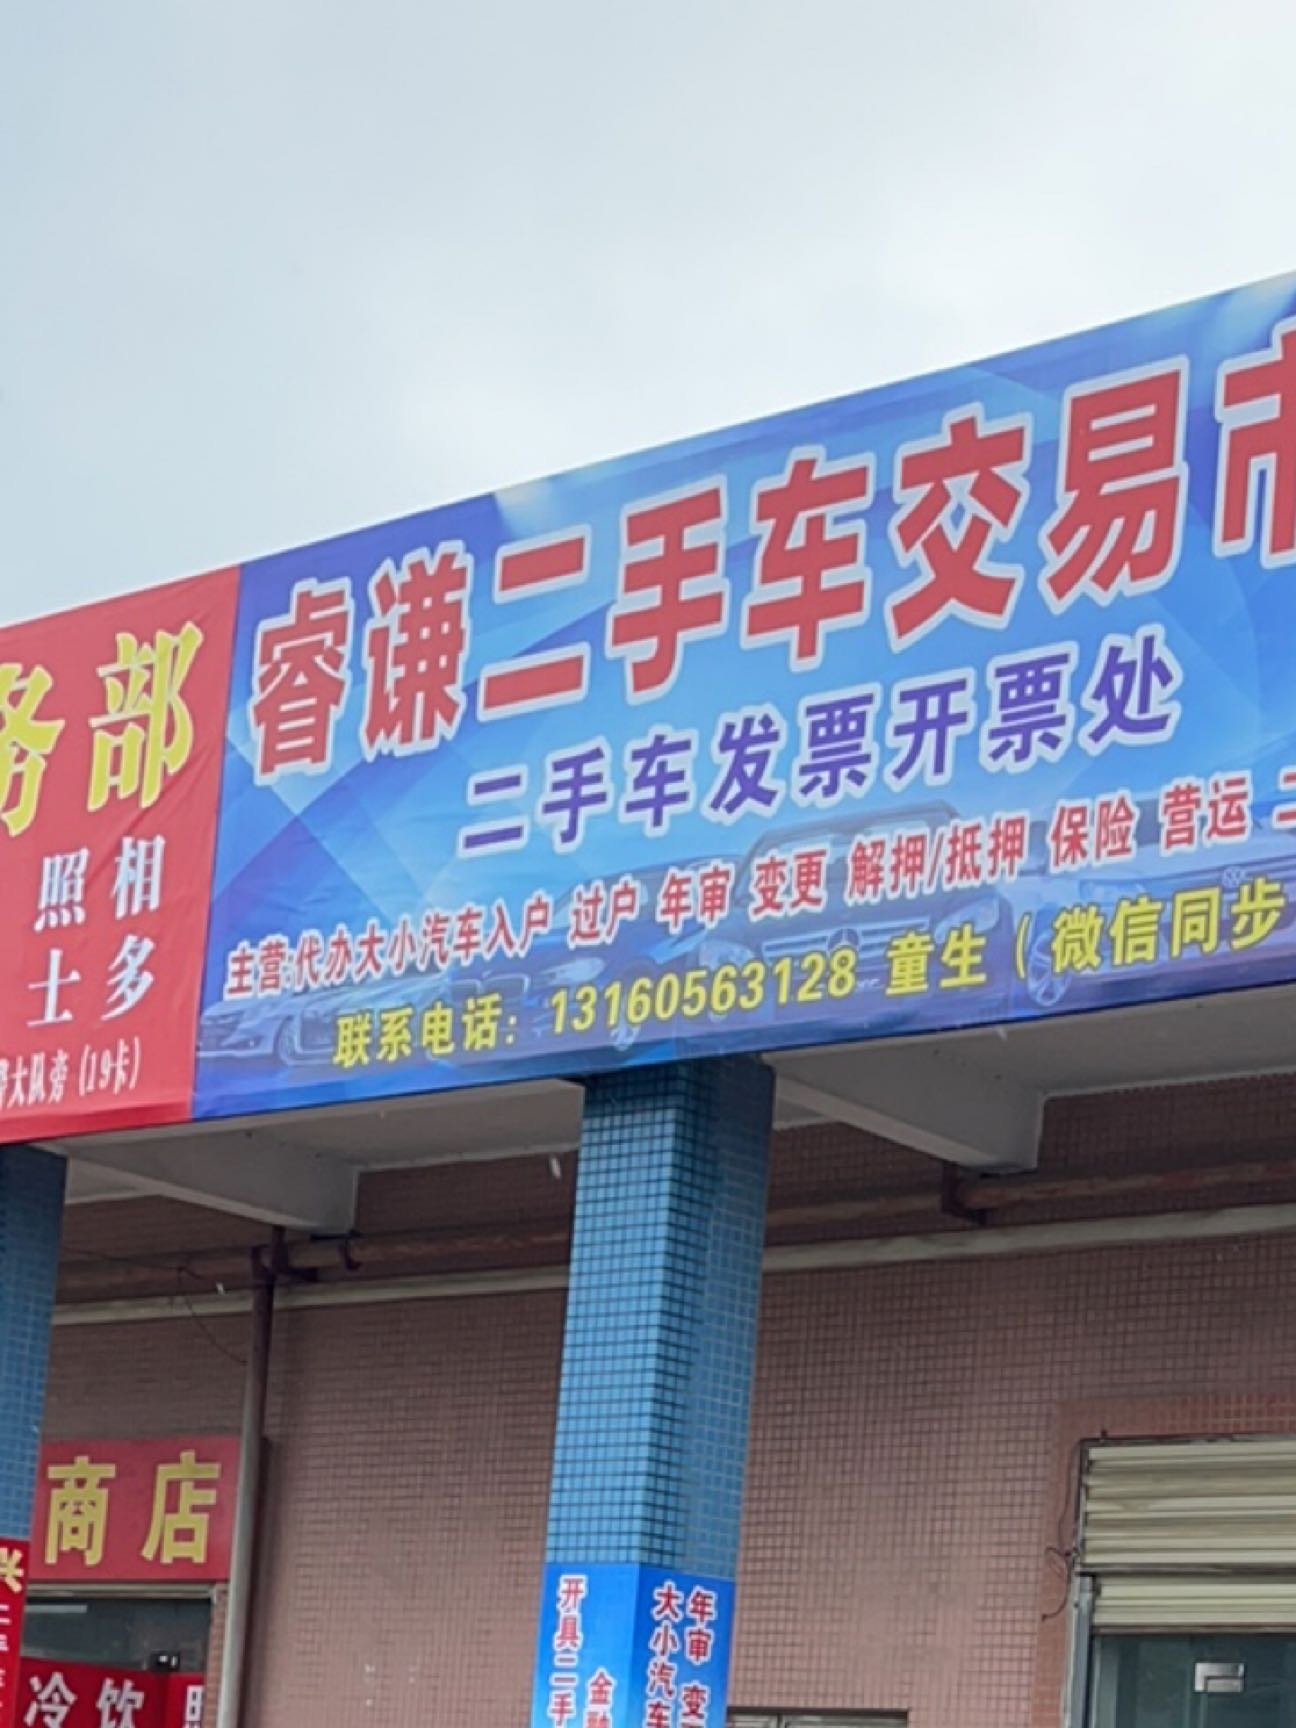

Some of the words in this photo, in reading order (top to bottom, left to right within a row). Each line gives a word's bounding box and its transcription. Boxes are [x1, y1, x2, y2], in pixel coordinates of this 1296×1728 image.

[460, 633, 1175, 854] 二手车发票开票处
[34, 834, 166, 932] 照相
[569, 881, 637, 944] 过户
[658, 867, 733, 931] 年审
[752, 849, 828, 915] 变更
[848, 816, 1026, 899] 解押/抵押
[1051, 796, 1135, 867] 保险
[1161, 777, 1249, 849] 营运
[26, 932, 156, 1028] 士多
[44, 1450, 221, 1567] 商店
[686, 1590, 714, 1663] 年审
